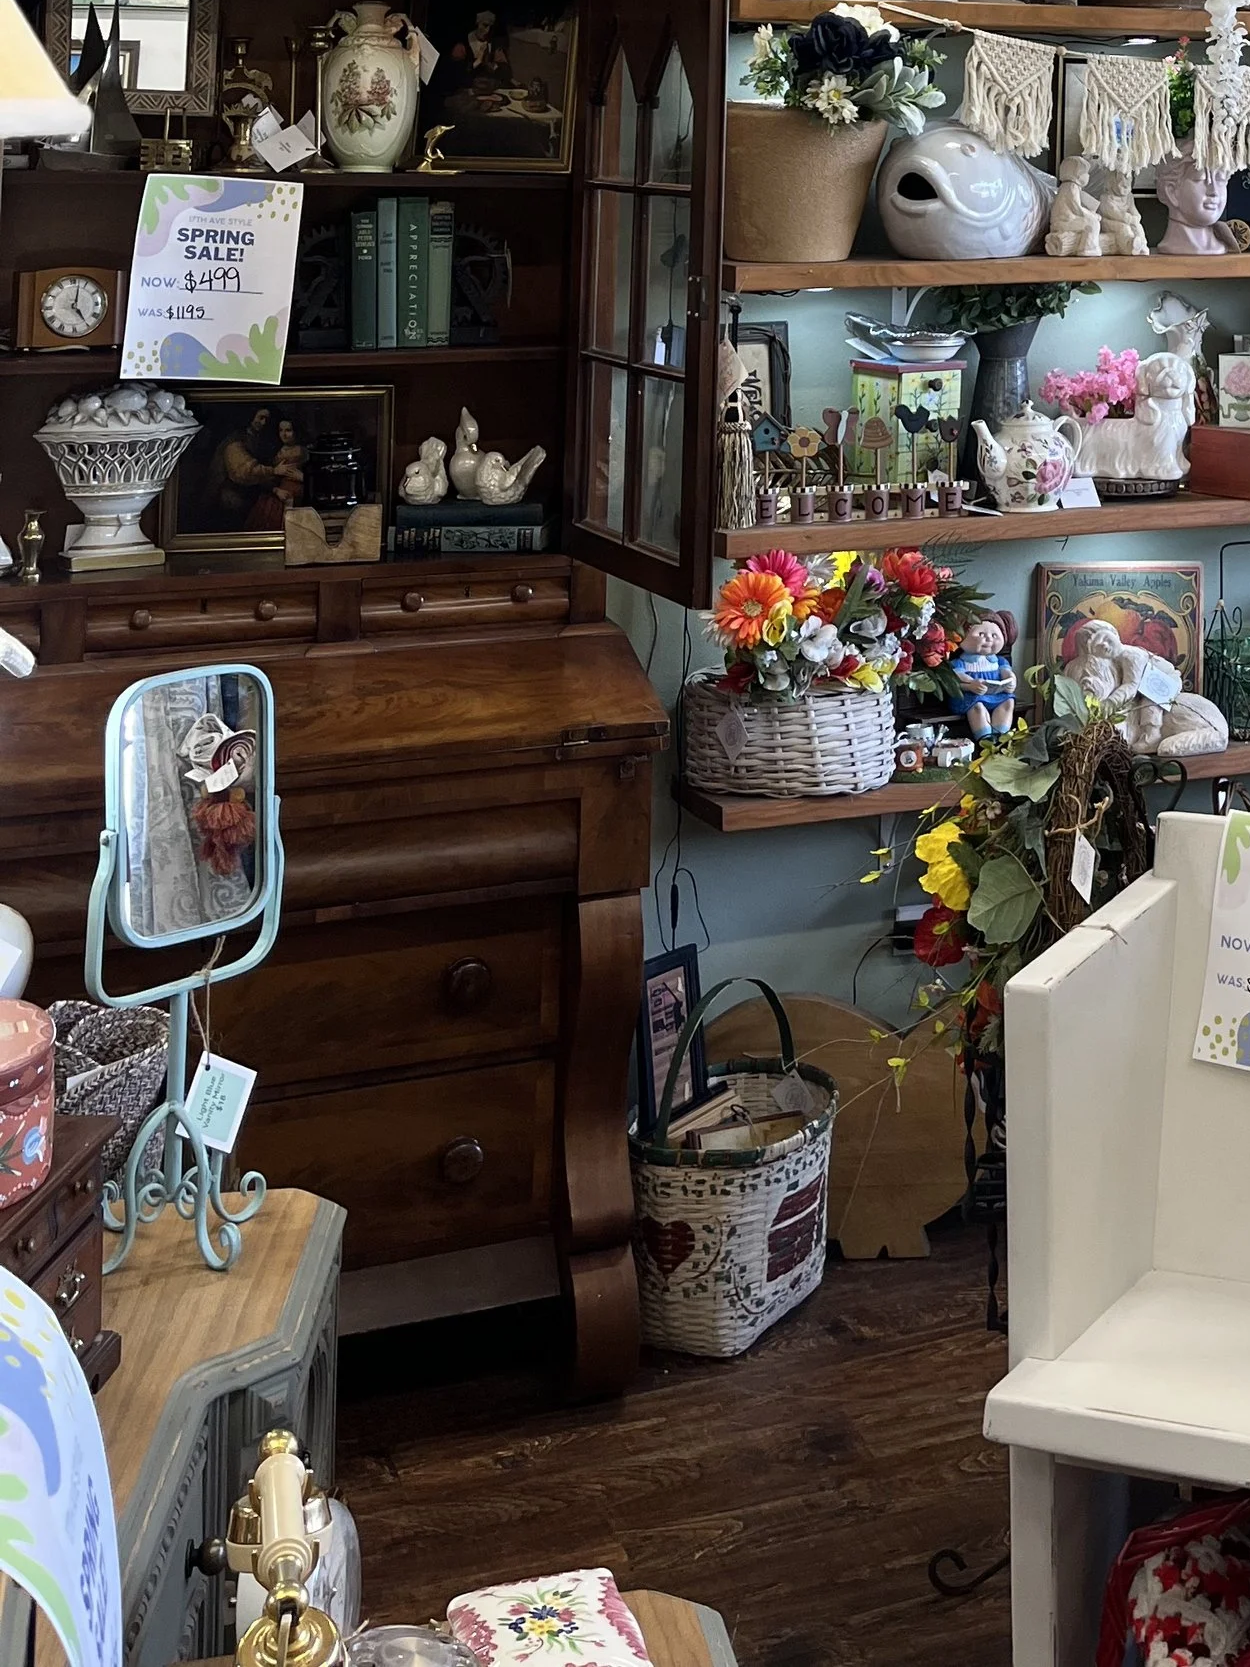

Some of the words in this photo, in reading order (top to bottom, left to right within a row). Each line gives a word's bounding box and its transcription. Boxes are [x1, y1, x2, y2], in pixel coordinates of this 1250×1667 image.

[209, 217, 225, 225] AVE
[229, 218, 252, 226] STYLE
[177, 228, 255, 246] SPRING
[184, 245, 244, 262] SALE!
[141, 276, 180, 289] NOW:
[184, 267, 241, 293] $499
[408, 223, 418, 340] APPRECIATION
[166, 305, 205, 320] $1195
[759, 492, 961, 519] ELCOME
[1072, 575, 1104, 588] Yakima
[1109, 574, 1136, 589] Valley
[1144, 575, 1172, 589] Apples
[197, 1098, 209, 1121] Light
[205, 1076, 216, 1095] Blue
[203, 1102, 216, 1128] Vanity
[213, 1074, 225, 1099] Mirror
